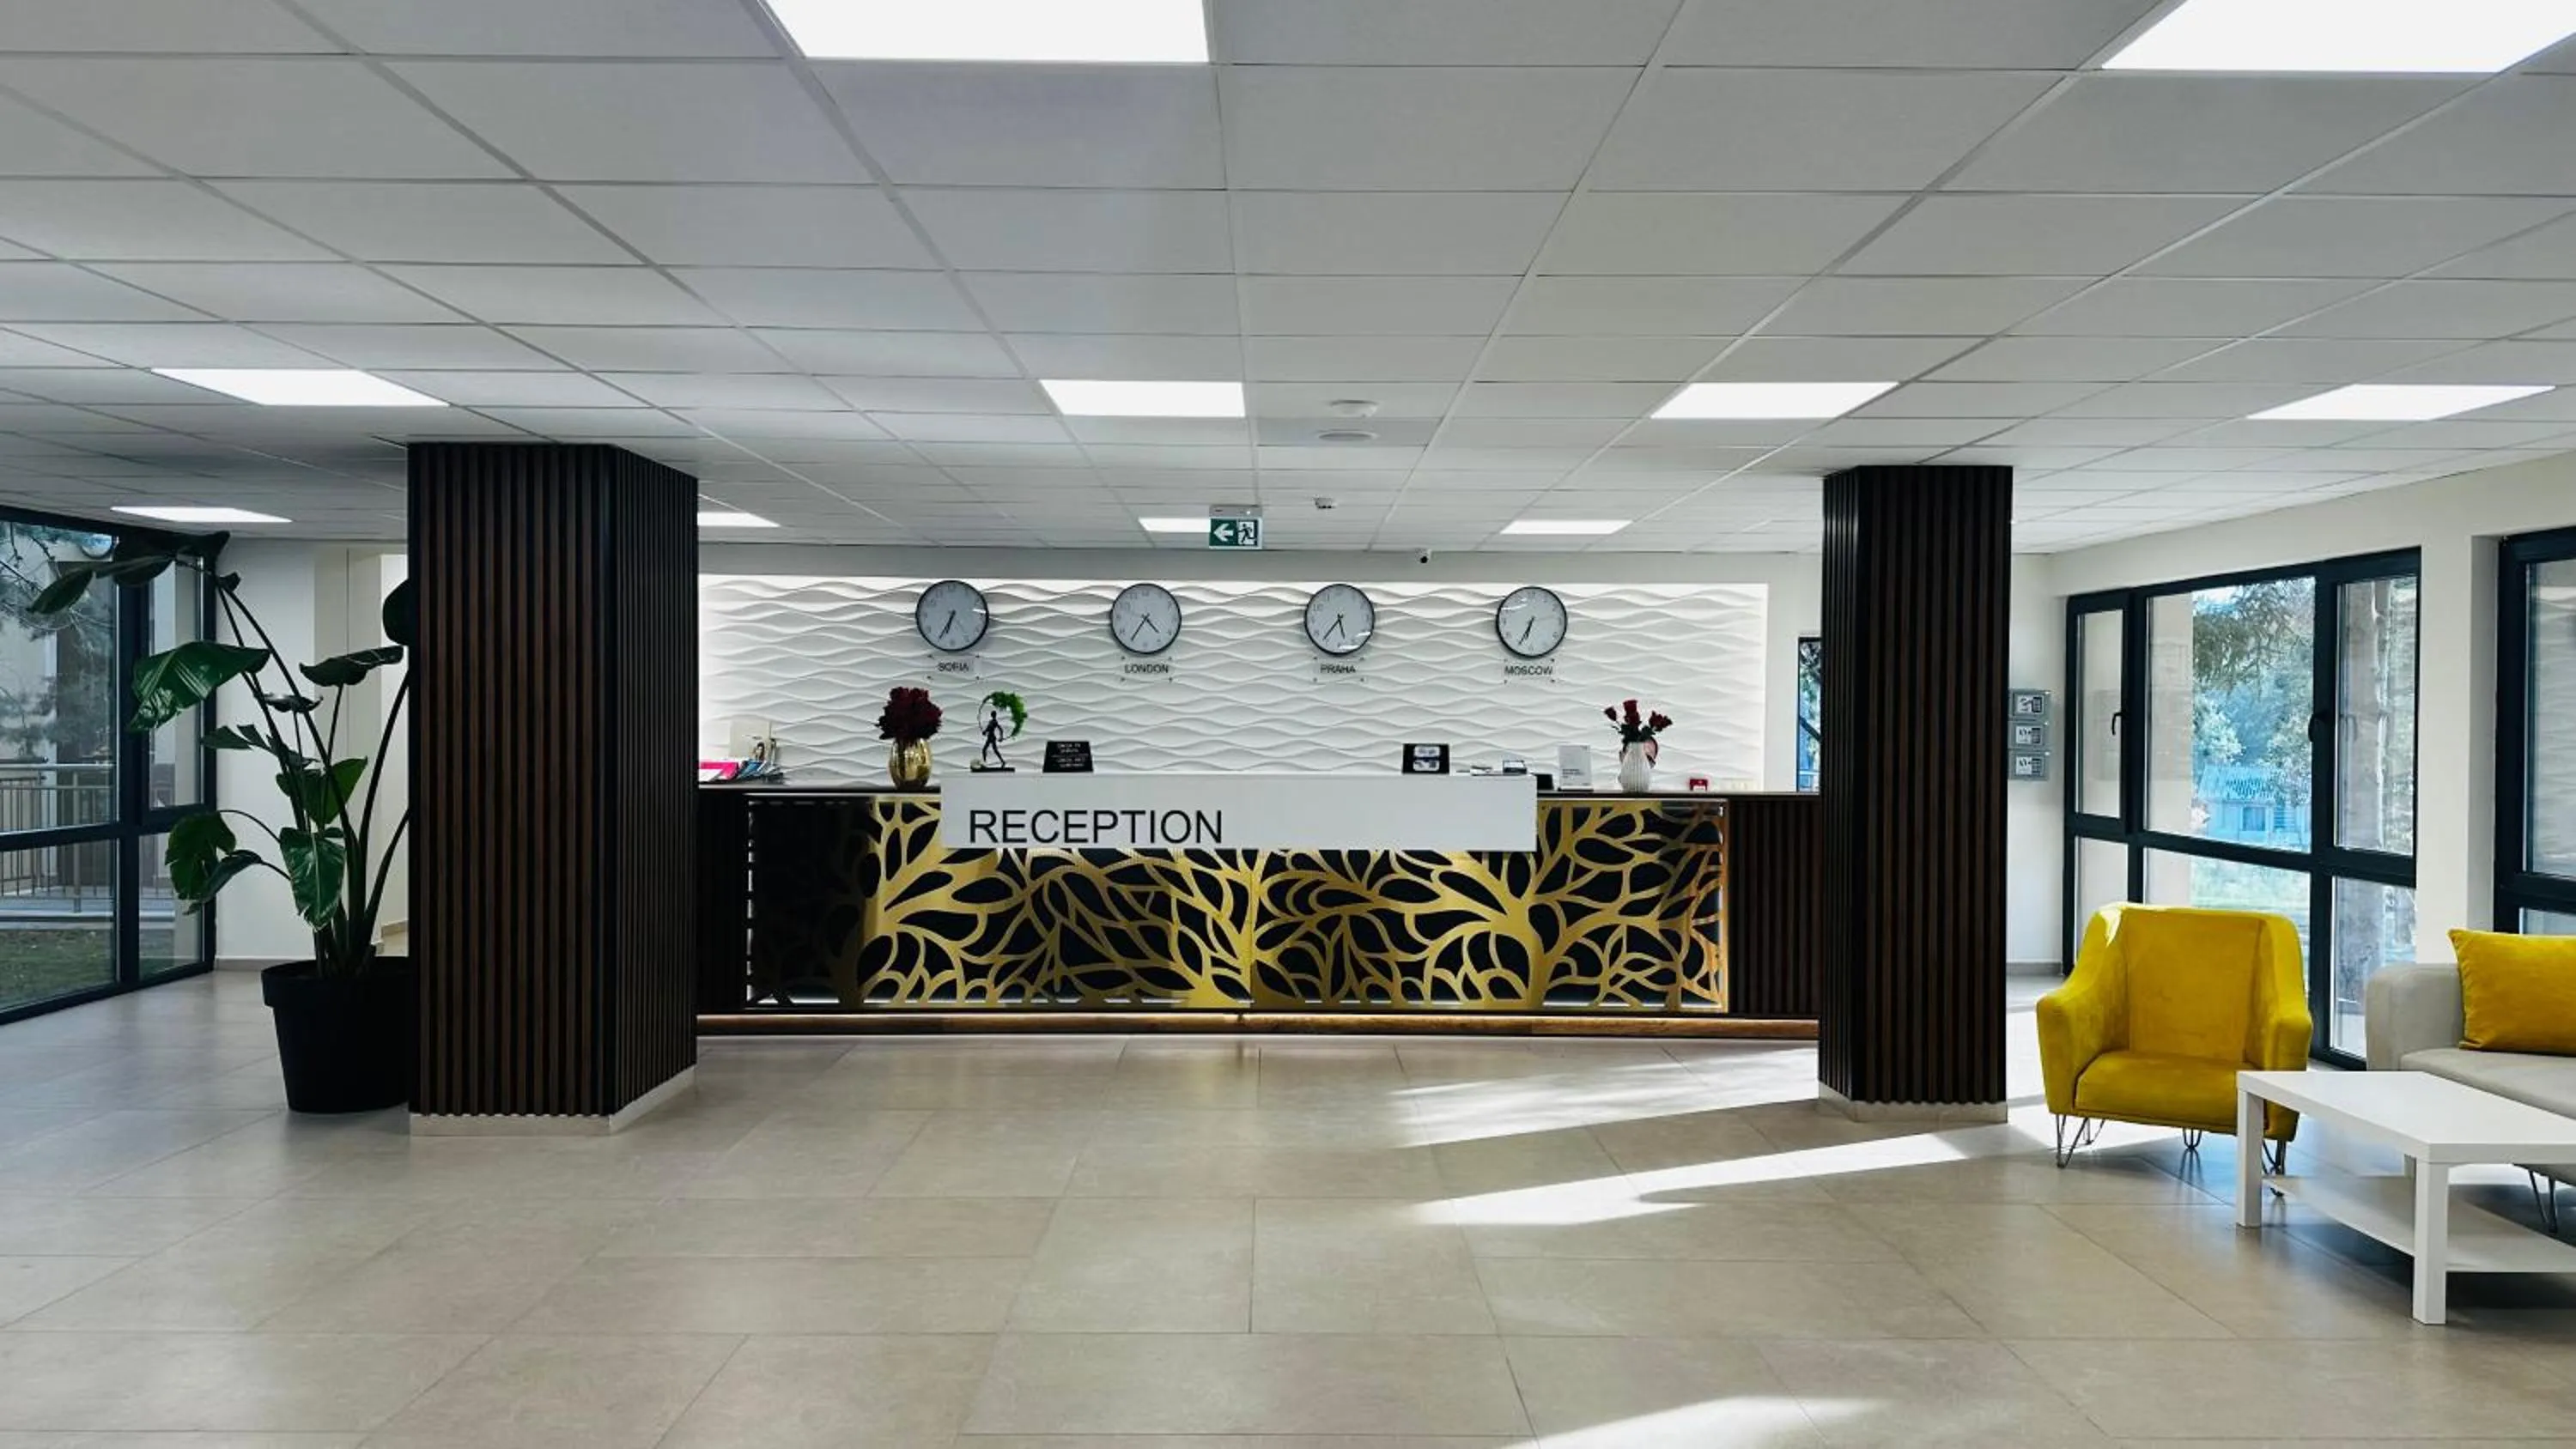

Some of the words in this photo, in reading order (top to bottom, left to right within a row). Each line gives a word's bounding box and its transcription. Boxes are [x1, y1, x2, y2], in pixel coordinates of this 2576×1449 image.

[938, 663, 969, 671] SOFIA
[1124, 664, 1169, 674] LONDON
[1320, 664, 1356, 673] PRAHA
[1504, 665, 1553, 676] MOSCOW
[969, 809, 1222, 844] RECEPTION
